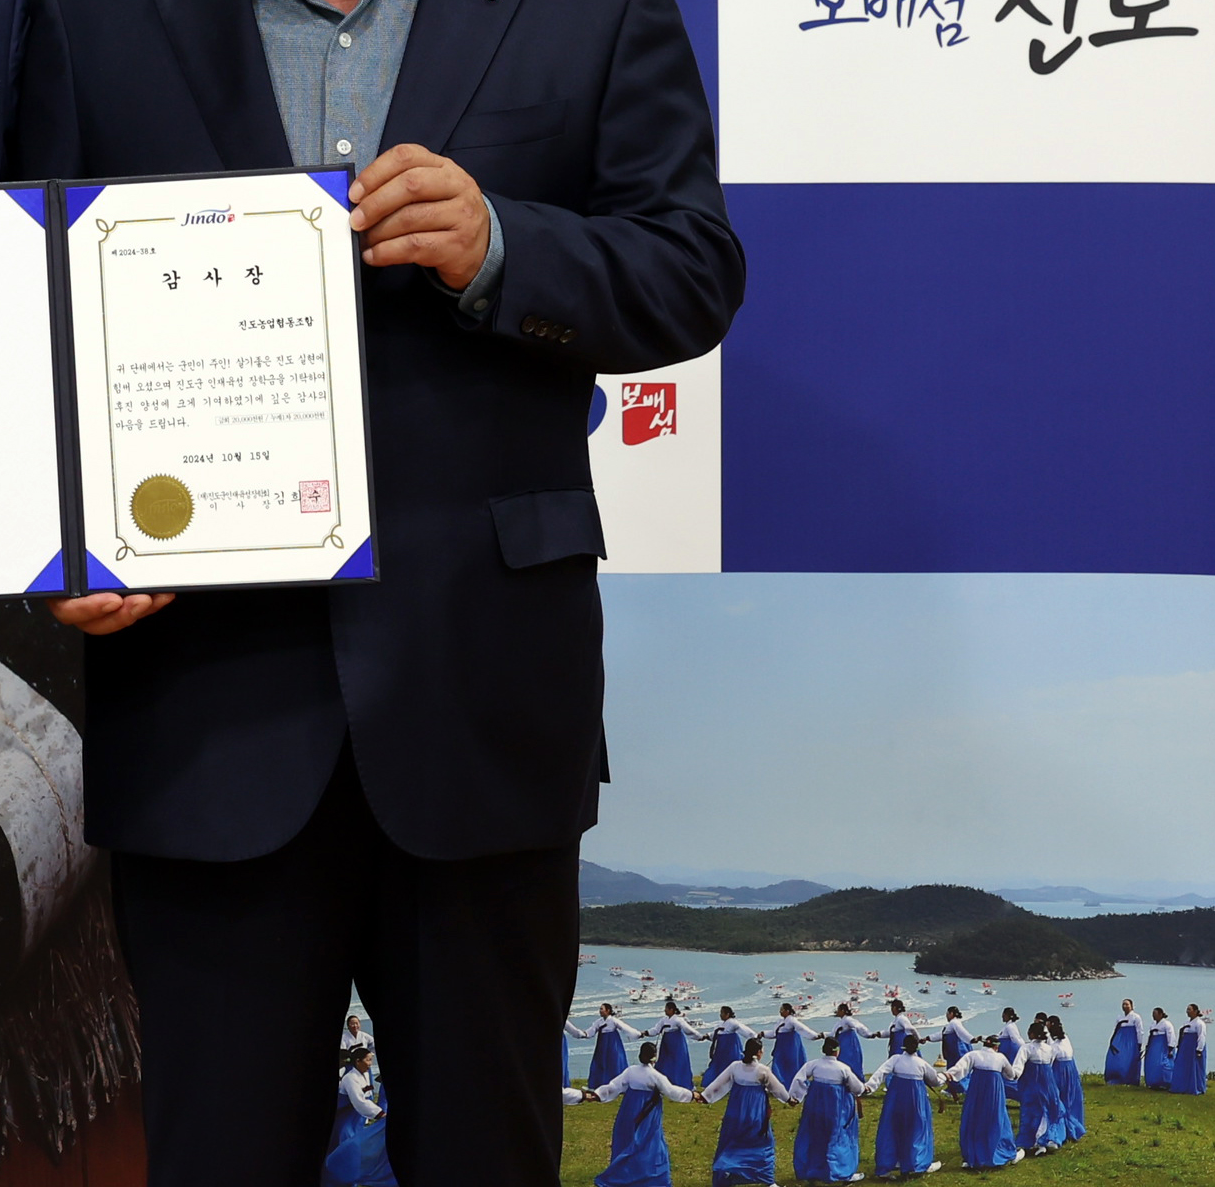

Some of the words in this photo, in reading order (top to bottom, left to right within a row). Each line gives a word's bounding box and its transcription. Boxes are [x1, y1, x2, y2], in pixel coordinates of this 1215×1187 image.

[181, 212, 226, 226] Jindo
[238, 315, 314, 331] 진도농업협동조합
[130, 360, 174, 374] 단체에서는
[179, 359, 204, 372] 군민이
[209, 357, 231, 369] 주인!
[236, 355, 272, 369] 살기좋은
[276, 354, 295, 366] 진도
[298, 352, 324, 365] 실현에
[136, 379, 171, 392] 오셨으며
[176, 377, 203, 391] 진도군
[207, 375, 244, 389] 인재육성
[248, 373, 285, 387] 장학금을
[289, 371, 326, 384] 기탁하여
[114, 400, 133, 413] 후진
[140, 398, 170, 411] 양성에
[177, 396, 196, 409] 크게
[203, 393, 264, 407] 기여하였기에
[271, 391, 291, 405] 깊은
[297, 390, 327, 404] 감사의
[115, 418, 143, 431] 마음을
[149, 416, 190, 430] 드립니다.
[182, 452, 214, 464] 2024년
[222, 451, 242, 463] 10월
[249, 450, 270, 461] 15일
